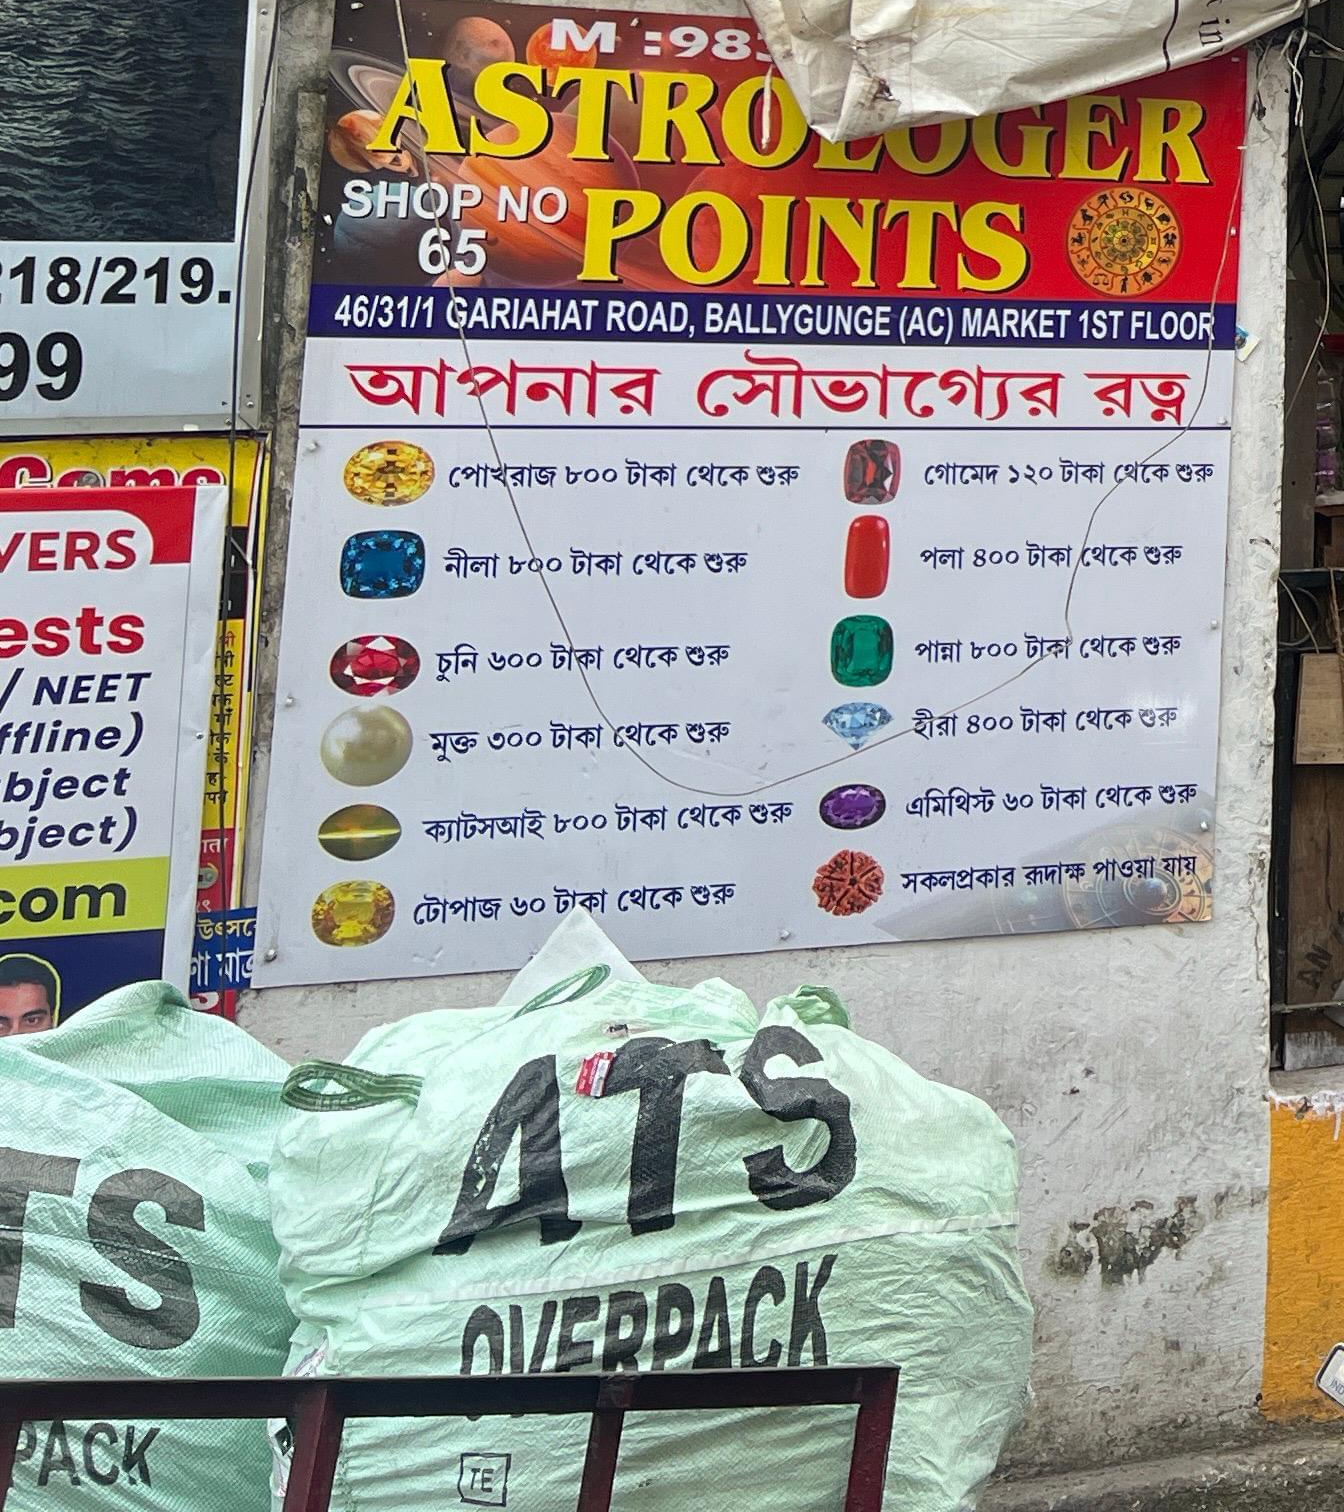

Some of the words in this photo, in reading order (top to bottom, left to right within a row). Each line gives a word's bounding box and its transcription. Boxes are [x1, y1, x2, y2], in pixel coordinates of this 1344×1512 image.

[341, 179, 484, 221] SHOP
[497, 187, 570, 226] NO
[417, 228, 489, 277] 65
[576, 187, 1031, 292] POINTS
[0, 256, 232, 306] 18/219.
[334, 295, 436, 329] 46/31/1
[445, 296, 600, 332] GARIAHAT
[606, 299, 696, 339] ROAD,
[704, 301, 892, 338] BALLYGUNGE
[899, 304, 955, 345] (AC)
[961, 307, 1073, 340] MARKET
[1078, 309, 1125, 340] 1ST
[1130, 311, 1216, 341] FLOOR
[344, 358, 663, 418] আপনার
[697, 349, 1066, 423] সৌভাগ্যের
[1085, 372, 1192, 426] রত্ন
[33, 672, 151, 706] NEET
[432, 1023, 859, 1256] ATS
[460, 1252, 840, 1377] OVERPACK
[470, 1464, 495, 1493] TE
